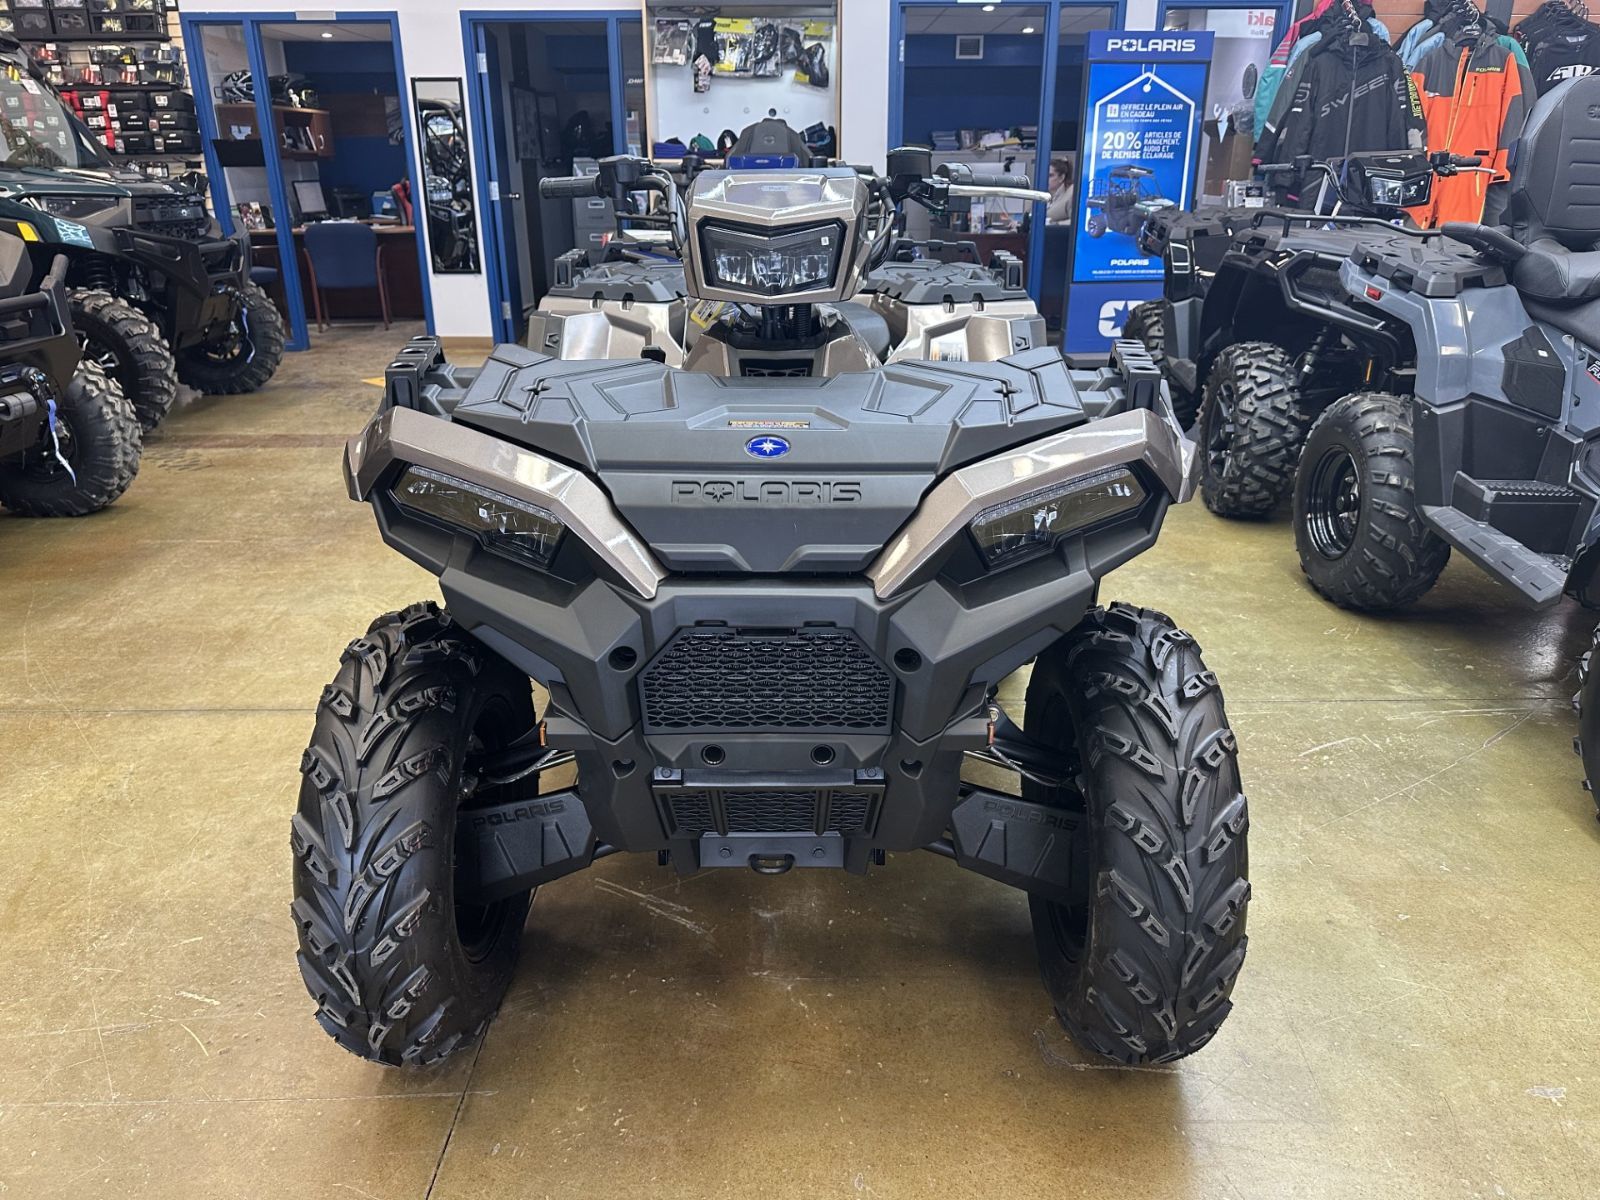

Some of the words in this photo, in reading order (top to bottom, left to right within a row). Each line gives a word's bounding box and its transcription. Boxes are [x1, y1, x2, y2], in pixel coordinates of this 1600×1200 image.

[1106, 39, 1196, 52] POLARIS
[1120, 103, 1145, 111] OFFREZ
[1154, 103, 1172, 111] PLEIN
[1103, 131, 1142, 150] 20%
[1144, 131, 1173, 139] ARTICLES
[1173, 131, 1182, 139] DE
[1143, 138, 1180, 146] RANGEMENT,
[1101, 150, 1111, 159] DE
[1113, 150, 1141, 159] REMISE
[671, 480, 862, 504] POLARIS
[472, 799, 567, 830] POLARIS
[983, 800, 1080, 832] POLARIS
